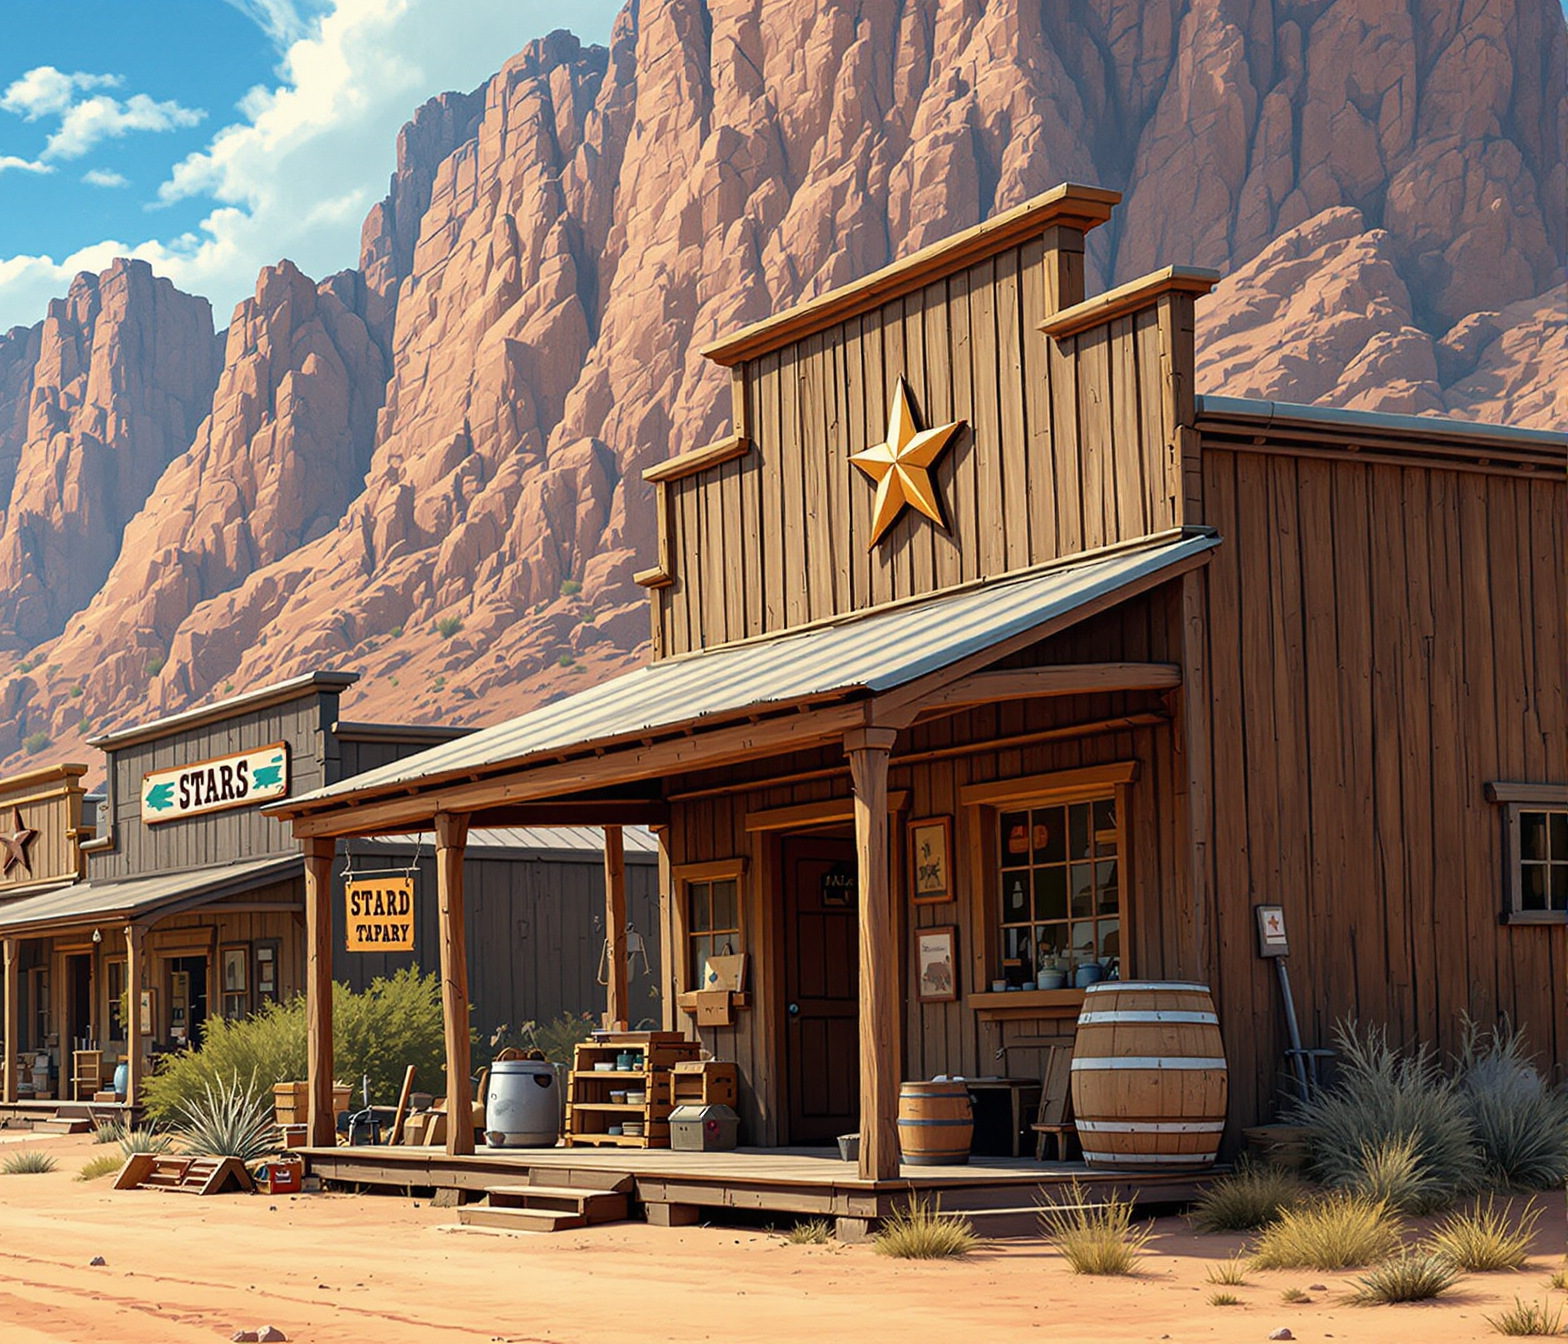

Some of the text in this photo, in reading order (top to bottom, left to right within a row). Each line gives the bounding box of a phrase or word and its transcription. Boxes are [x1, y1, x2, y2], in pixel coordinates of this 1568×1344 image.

[179, 759, 249, 809] STARS
[350, 889, 411, 916] STARD
[355, 923, 410, 943] TAPARY
